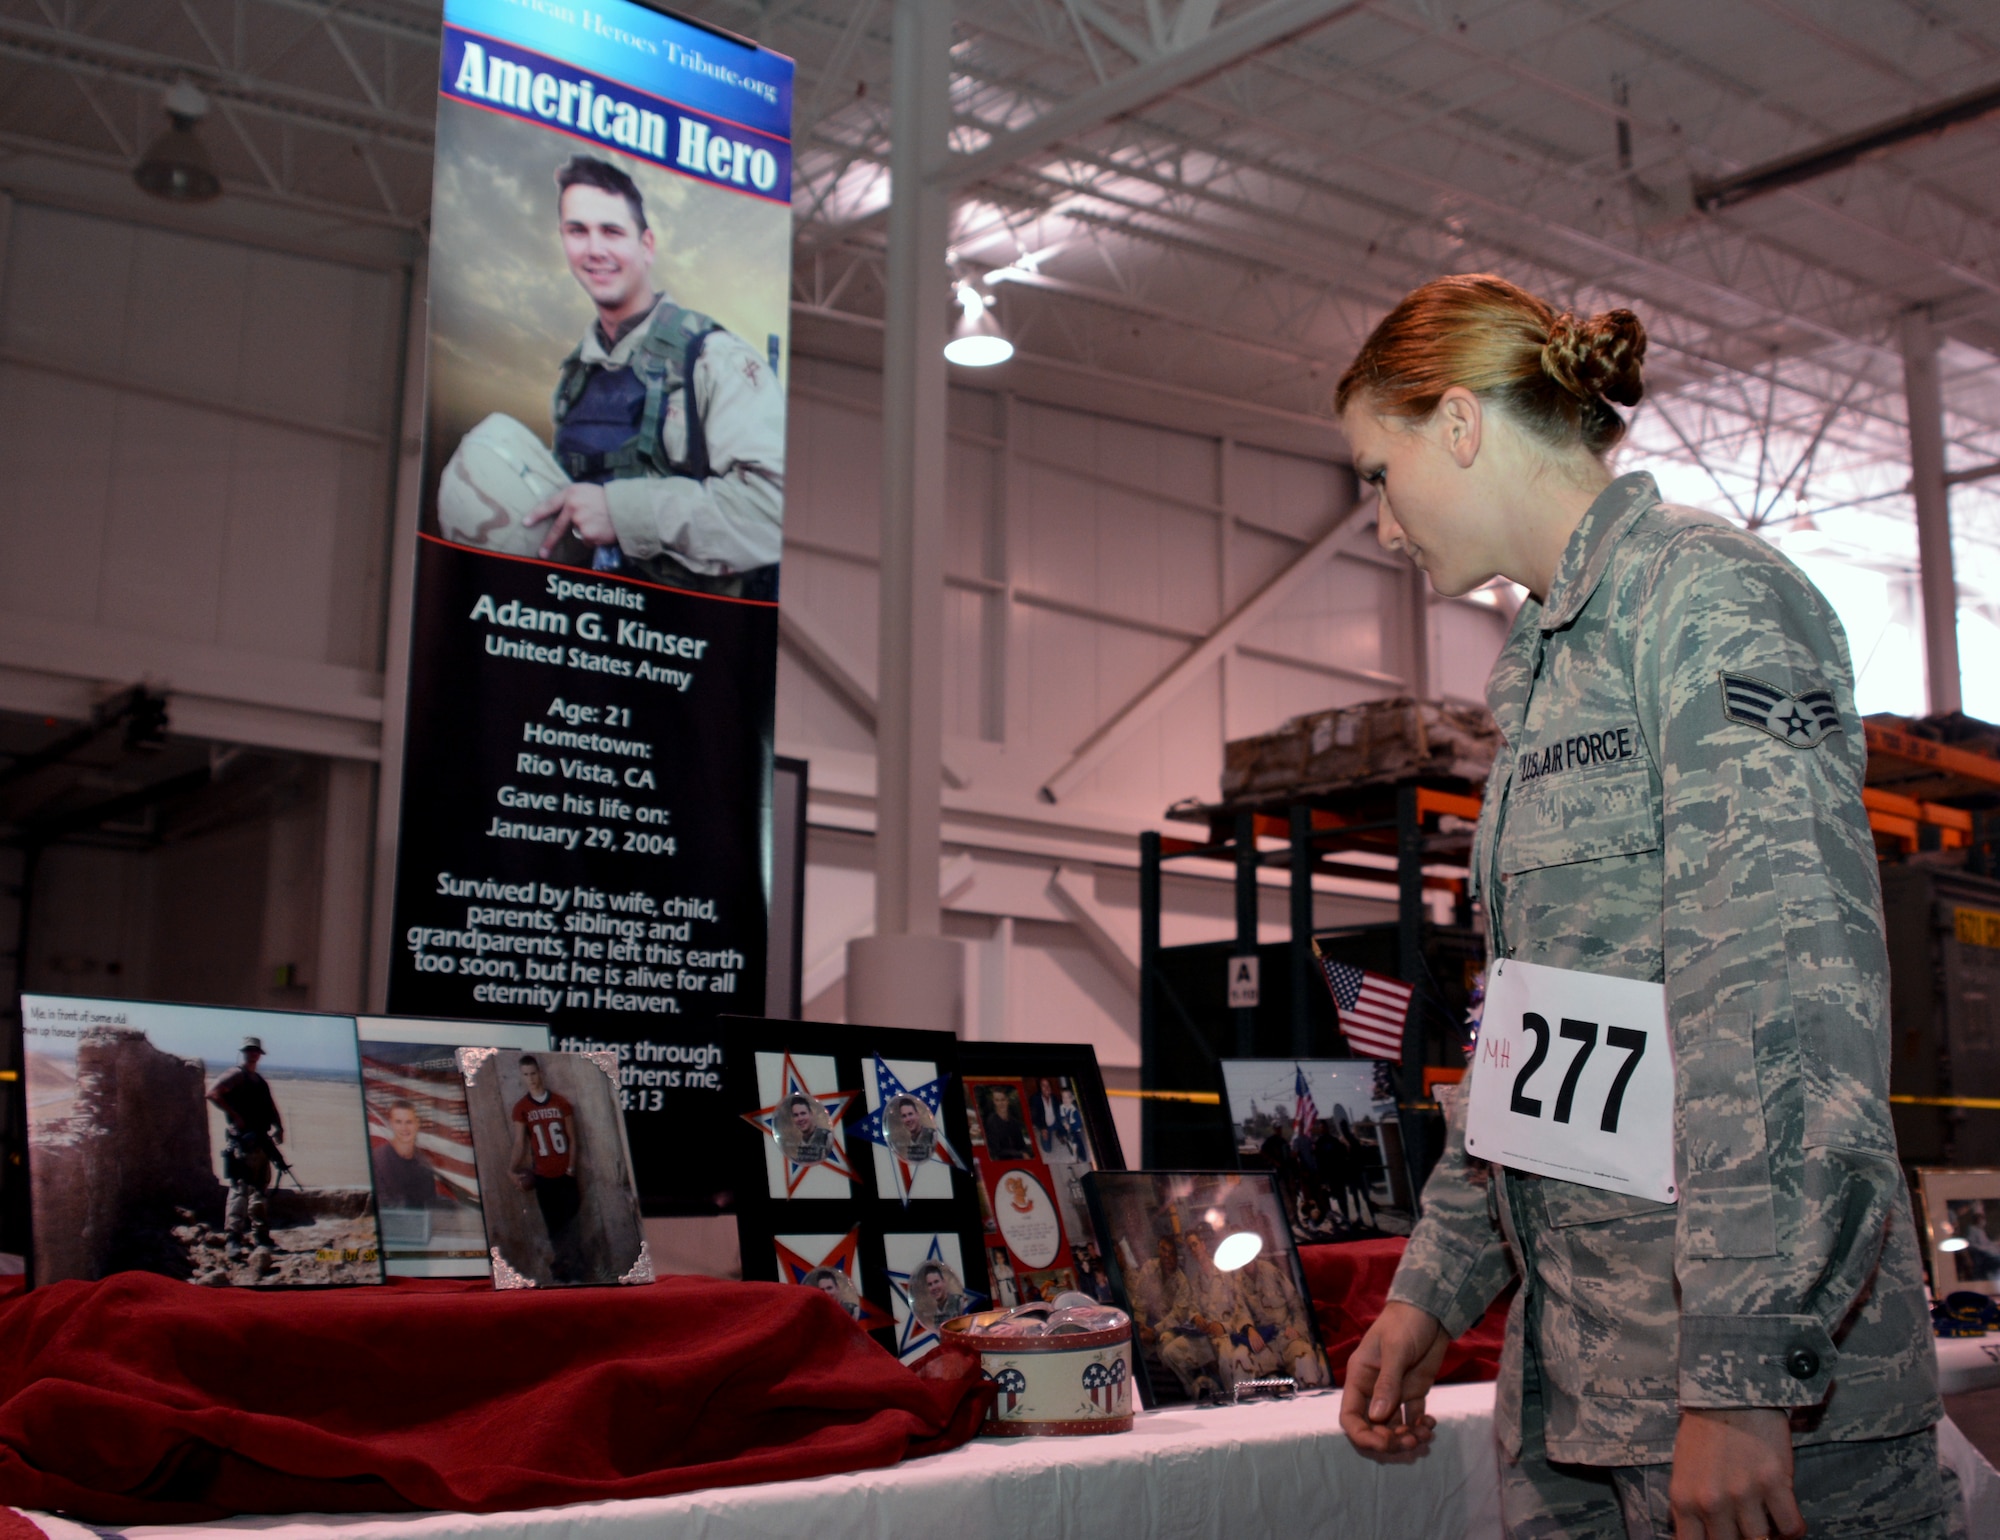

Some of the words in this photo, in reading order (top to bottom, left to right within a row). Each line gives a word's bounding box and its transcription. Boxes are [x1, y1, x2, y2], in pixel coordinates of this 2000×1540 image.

[582, 10, 657, 55] Heroes
[662, 38, 777, 104] Tribute.org
[455, 41, 667, 159] American
[677, 116, 777, 191] Hero
[546, 573, 644, 611] Specialist
[469, 594, 569, 634] Adam
[576, 613, 608, 642] G.
[616, 619, 707, 659] Kinser
[485, 634, 563, 665] United
[567, 648, 632, 676] States
[635, 660, 692, 692] Army
[547, 697, 599, 725] Age:
[604, 705, 631, 728] 21
[523, 723, 653, 759] Hometown:
[1521, 752, 1539, 782] U.S.
[1541, 743, 1563, 776] AIR
[1566, 728, 1632, 769] FORCE
[516, 752, 554, 776] Rio
[560, 758, 618, 787] Vista,
[624, 767, 655, 789] CA
[497, 786, 556, 811] Gave
[562, 793, 593, 815] his
[599, 797, 630, 820] life
[636, 807, 670, 825] on:
[485, 817, 579, 850] January
[584, 828, 618, 853] 29,
[623, 832, 677, 856] 2004
[436, 872, 536, 903] Survived
[539, 882, 569, 912] by
[573, 886, 605, 908] his
[609, 891, 658, 917] wife,
[663, 896, 719, 922] child,
[466, 905, 559, 933] parents,
[564, 911, 644, 944] siblings
[648, 921, 690, 942] and
[407, 926, 568, 959] grandparents,
[573, 938, 602, 959] he
[607, 938, 641, 962] left
[645, 943, 682, 965] this
[686, 948, 743, 969] earth
[414, 951, 455, 972] too
[459, 957, 521, 981] soon,
[525, 957, 566, 982] but
[571, 962, 599, 984] he
[605, 964, 621, 985] is
[625, 966, 672, 989] alive
[677, 969, 705, 991] for
[709, 971, 736, 993] all
[1236, 963, 1251, 984] A
[57, 1008, 78, 1022] front
[90, 1013, 112, 1024] some
[473, 984, 563, 1012] eternity
[567, 987, 589, 1007] in
[594, 989, 681, 1014] Heaven.
[51, 1026, 76, 1038] house
[423, 1058, 455, 1070] FREED
[634, 1040, 722, 1070] through
[1482, 1038, 1511, 1069] MH
[1510, 1011, 1648, 1134] 277
[684, 1070, 723, 1091] me,
[533, 1121, 567, 1157] 16
